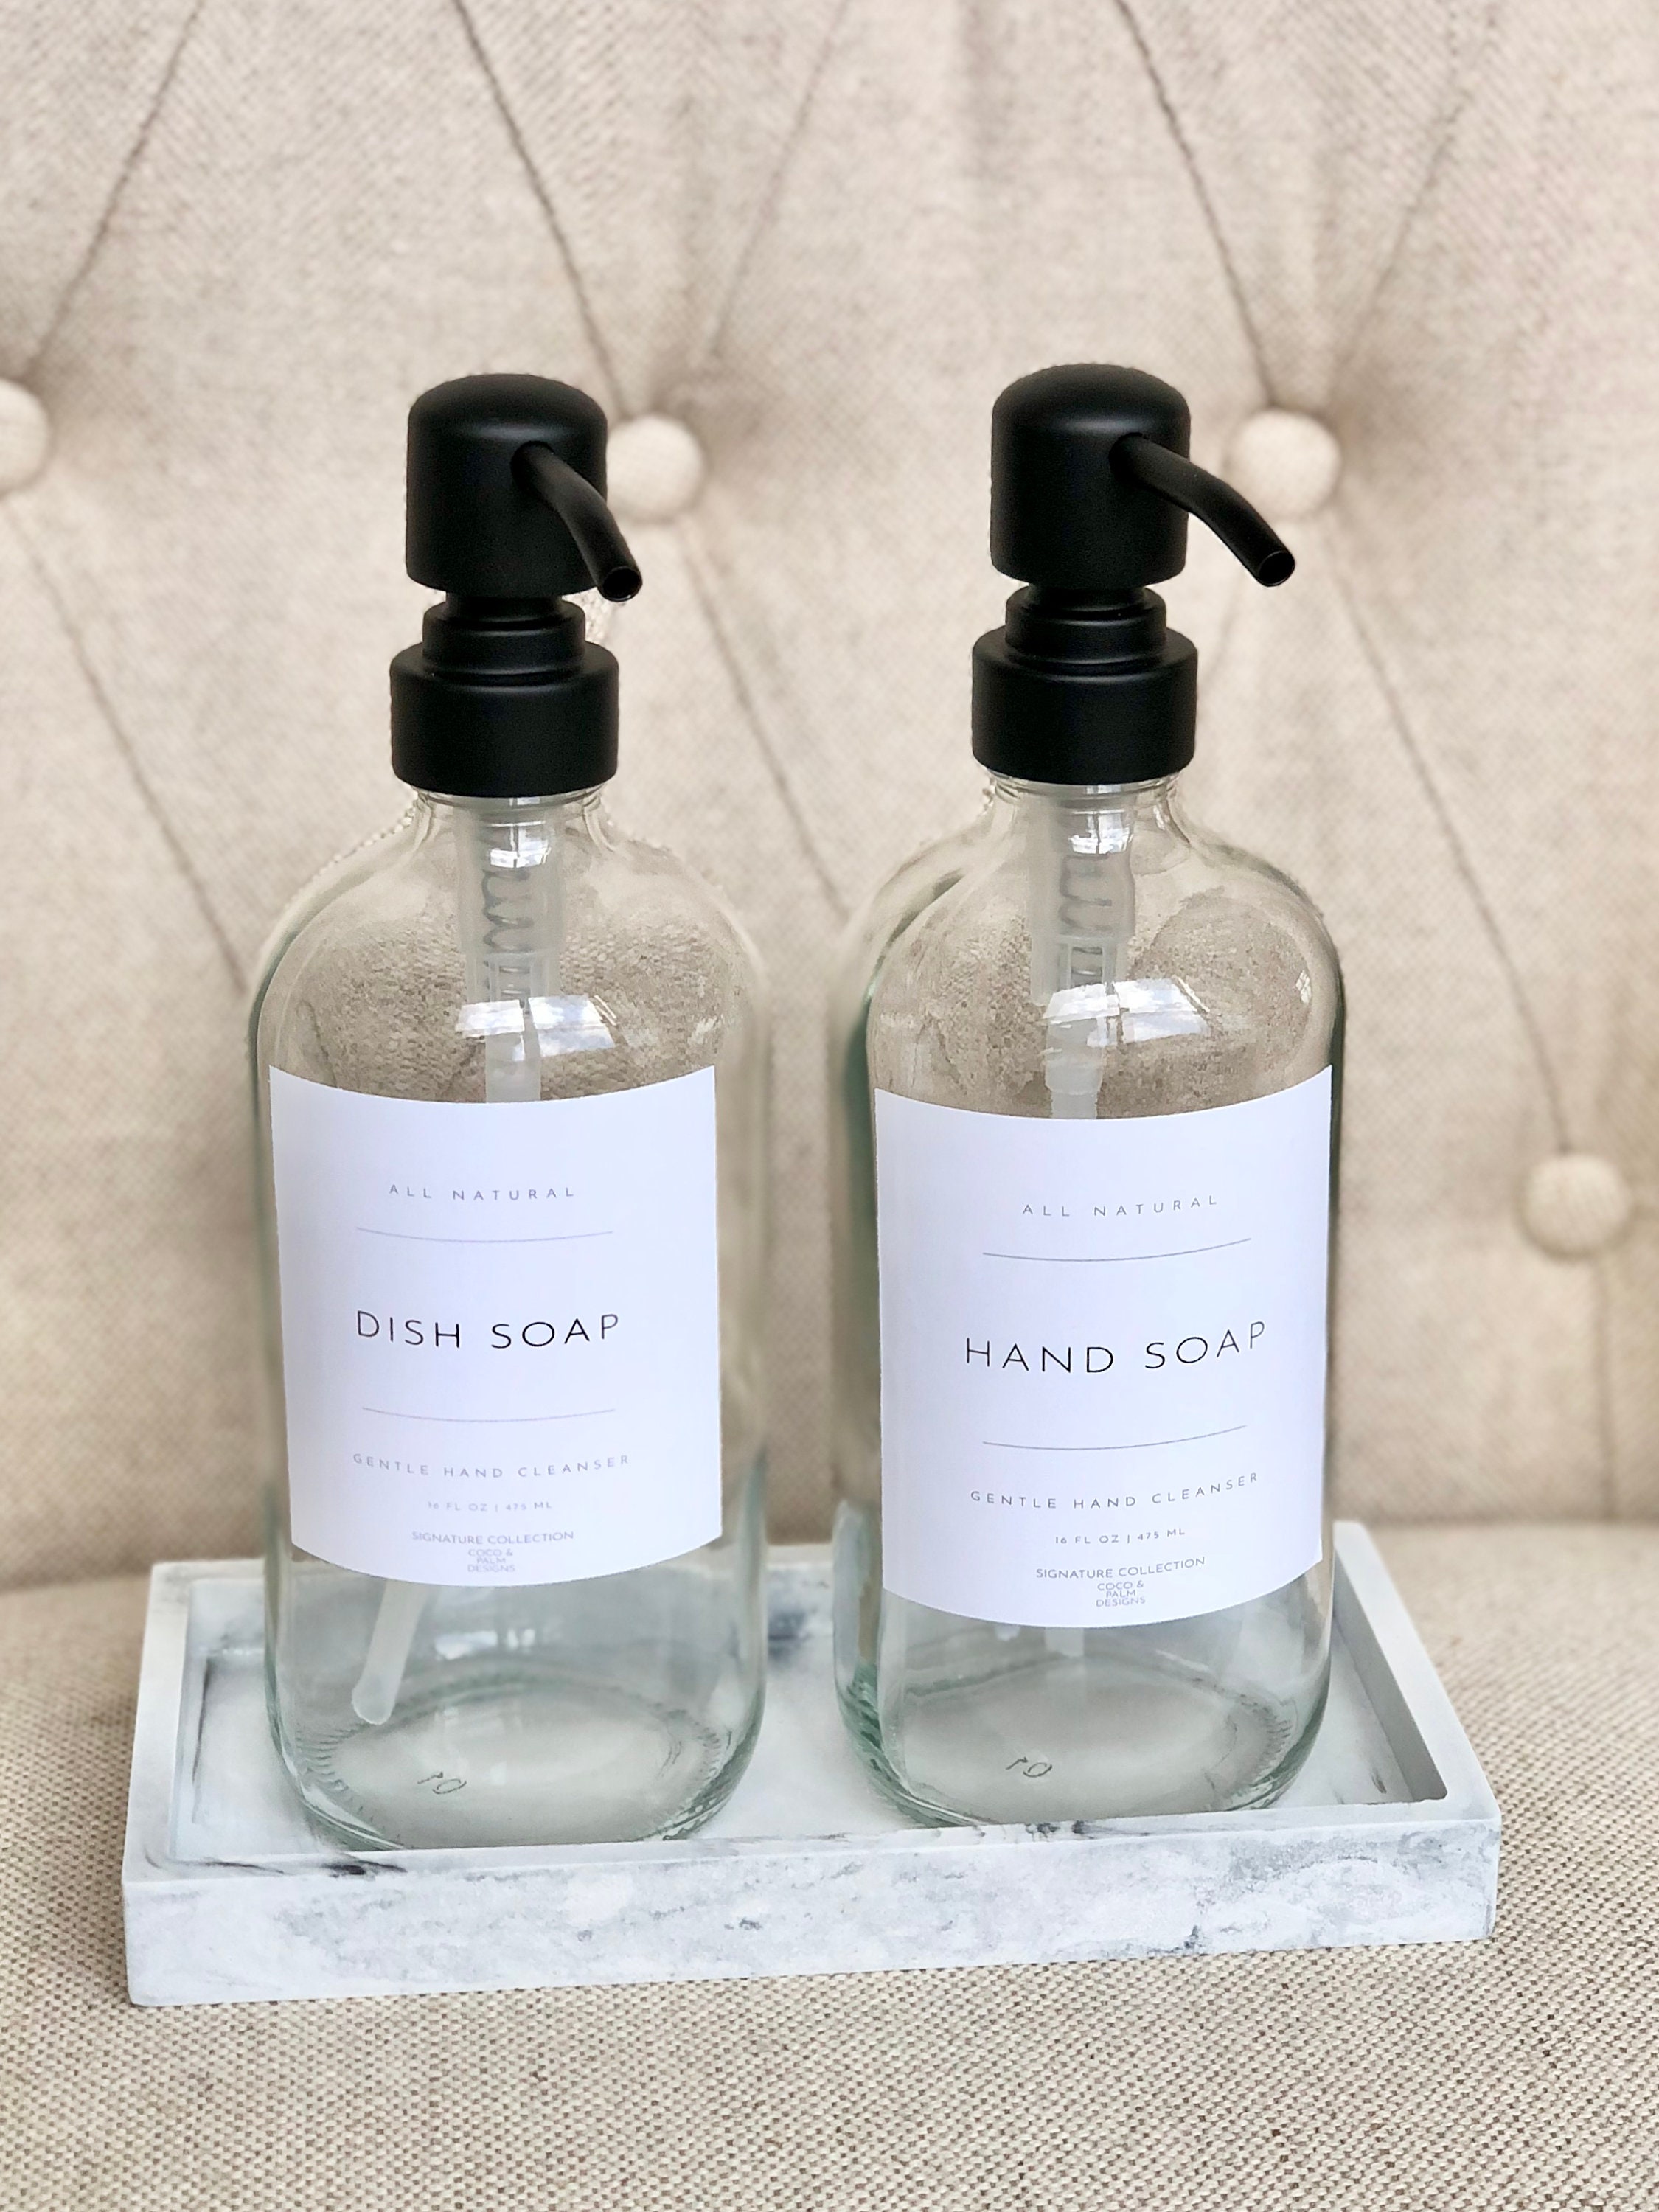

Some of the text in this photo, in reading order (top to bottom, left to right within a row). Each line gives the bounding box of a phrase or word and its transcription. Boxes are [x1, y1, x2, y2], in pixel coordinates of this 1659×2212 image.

[389, 1184, 574, 1201] ALL NATURAL
[1022, 1195, 1217, 1217] ALL NATURAL
[358, 1310, 619, 1349] DISH SOAP
[967, 1321, 1265, 1374] HAND SOAP
[353, 1453, 628, 1479] GENTLE HAND CLEANSER
[971, 1472, 1256, 1510] GENTLE HAND CLEANSER
[411, 1531, 574, 1545] SIGNATURE COLLECTION
[1055, 1536, 1068, 1545] 16
[1074, 1535, 1091, 1545] FL
[1098, 1534, 1120, 1544] OZ
[1136, 1531, 1160, 1541] 475
[1166, 1527, 1186, 1538] ML
[467, 1548, 503, 1557] COCO
[467, 1564, 516, 1573] DESIGNS
[1035, 1557, 1205, 1579] SIGNATURE COLLECTION
[1096, 1579, 1144, 1592] COCO &
[1105, 1590, 1137, 1598] PALM
[1096, 1596, 1147, 1608] DESIGNS
